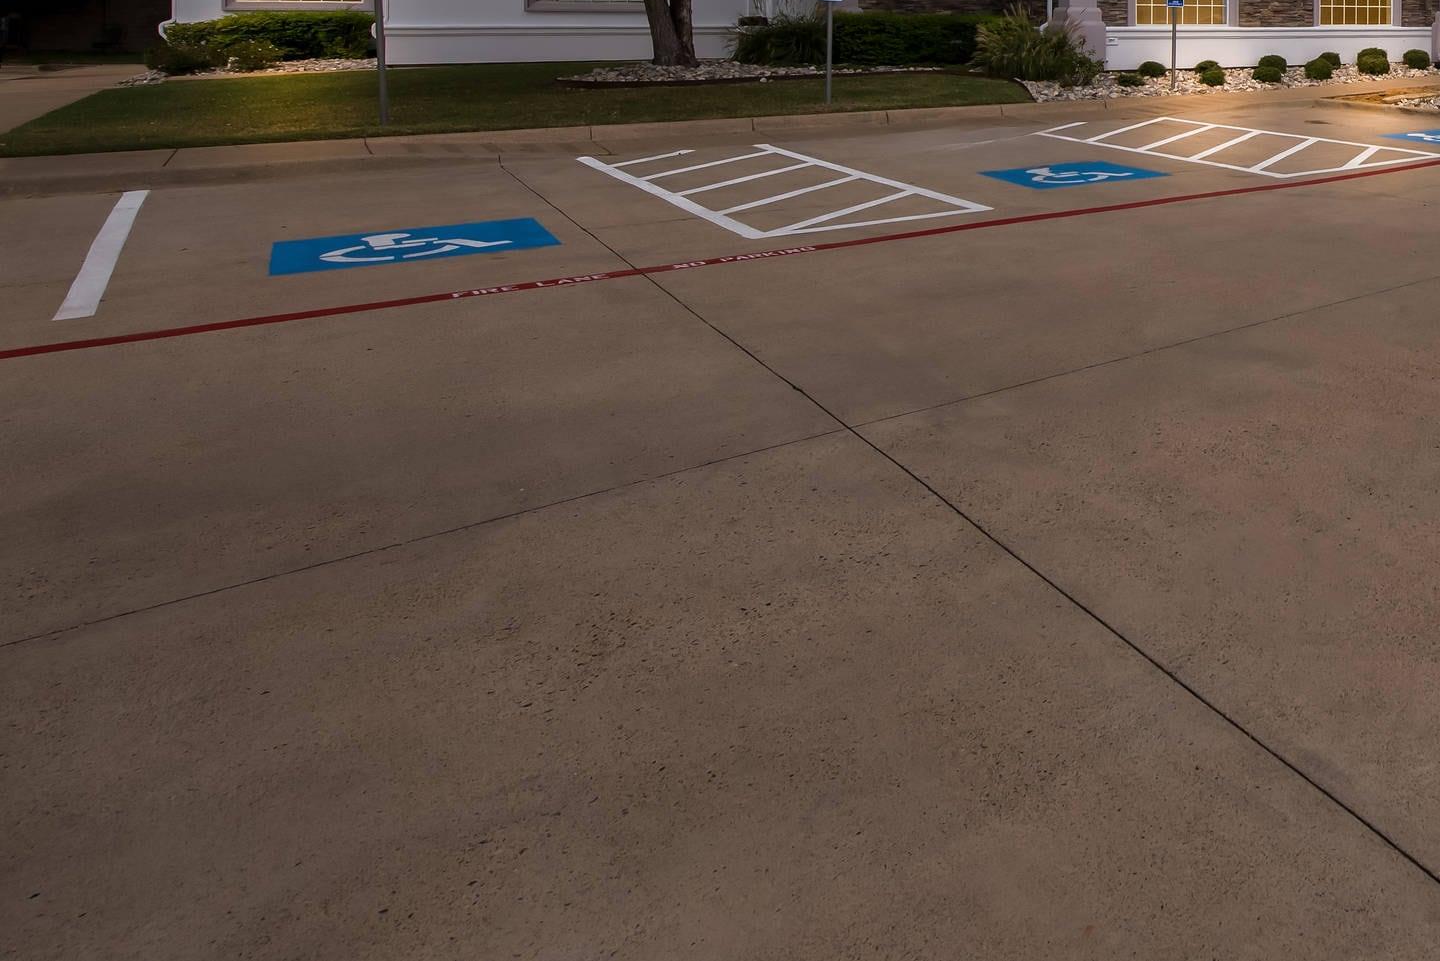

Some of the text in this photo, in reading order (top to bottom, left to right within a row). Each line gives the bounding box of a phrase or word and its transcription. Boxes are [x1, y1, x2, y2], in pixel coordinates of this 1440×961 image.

[452, 245, 816, 298] FIRE LANE NO PARKING
